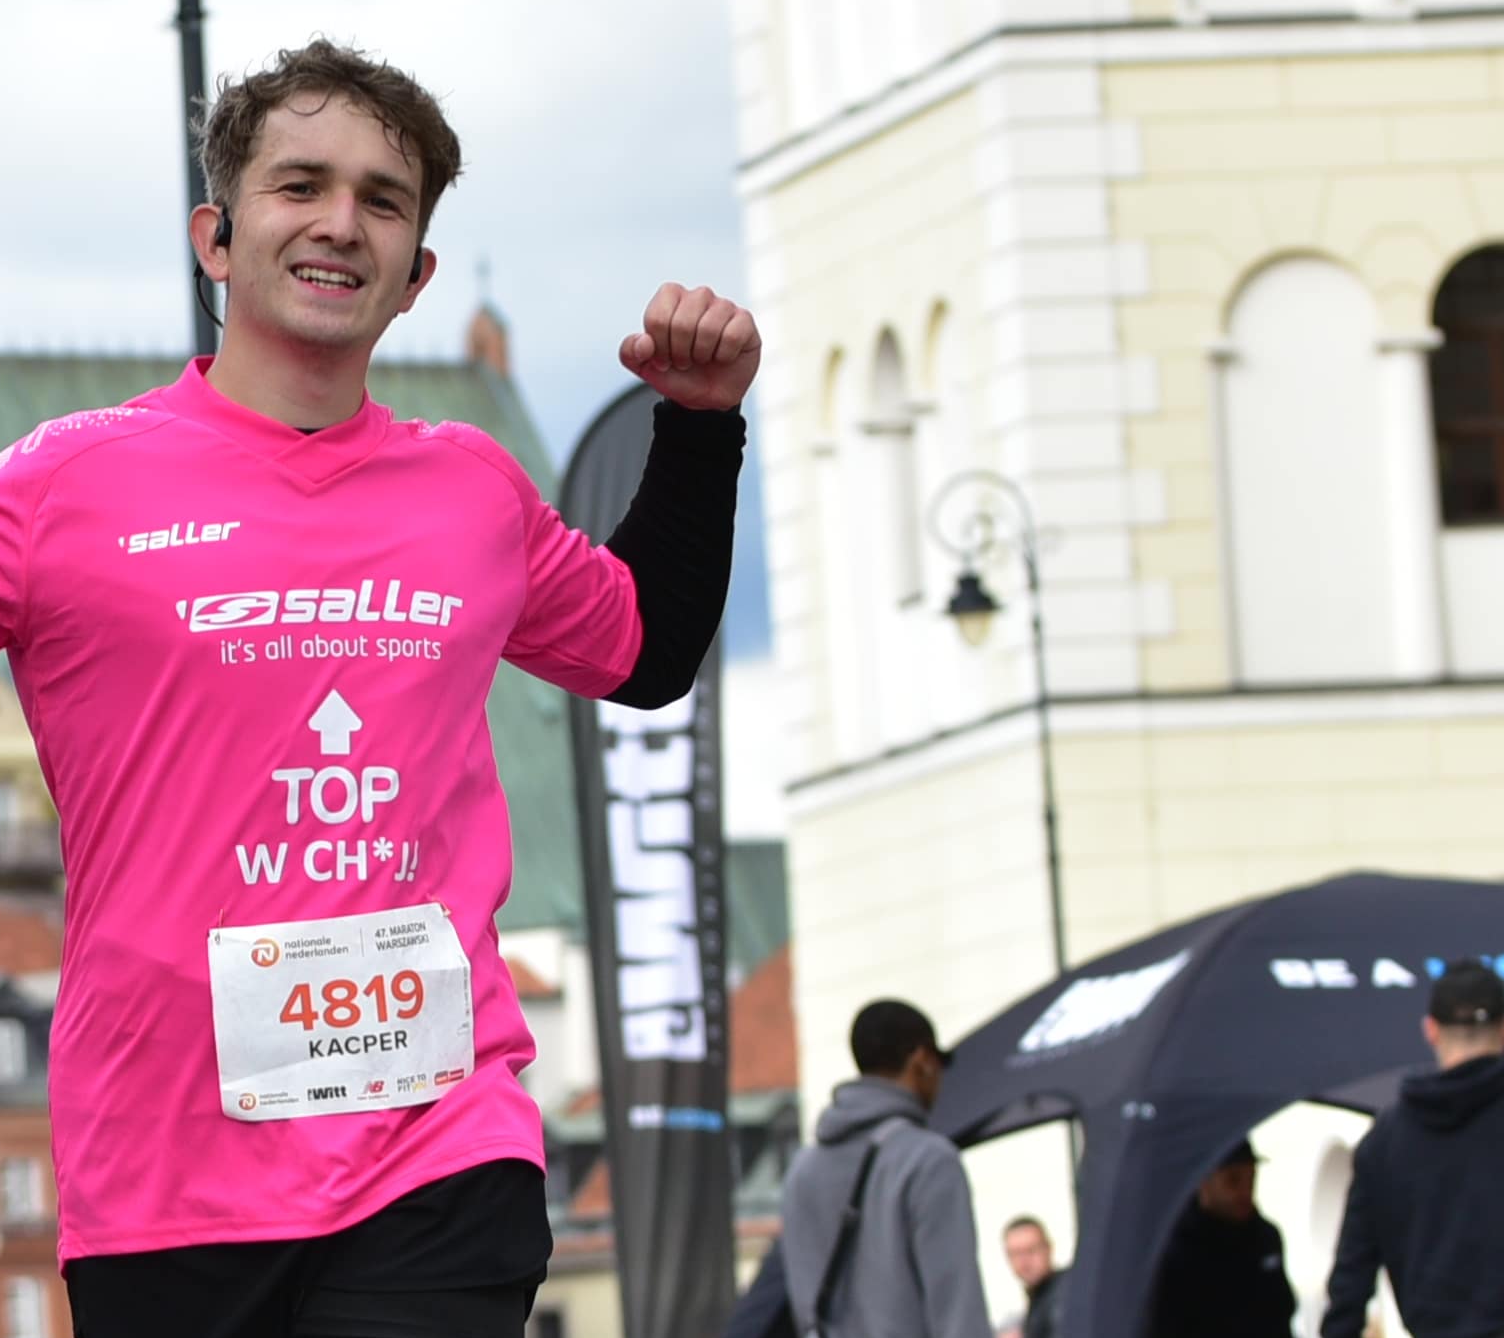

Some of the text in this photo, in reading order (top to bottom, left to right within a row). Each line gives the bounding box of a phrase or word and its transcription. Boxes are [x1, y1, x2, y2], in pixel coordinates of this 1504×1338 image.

[128, 521, 240, 554] saller
[280, 579, 462, 627] saller
[220, 634, 442, 665] it's all about sports
[271, 766, 400, 825] TOP
[235, 843, 288, 884] W
[284, 936, 332, 949] nationale
[375, 922, 426, 939] 47. MARATON
[376, 934, 429, 951] WARSZAWSKI
[285, 945, 349, 960] nederlanden
[1270, 958, 1358, 988] BE
[1372, 958, 1415, 987] A
[279, 969, 425, 1031] 4819
[308, 1030, 408, 1058] KACPER
